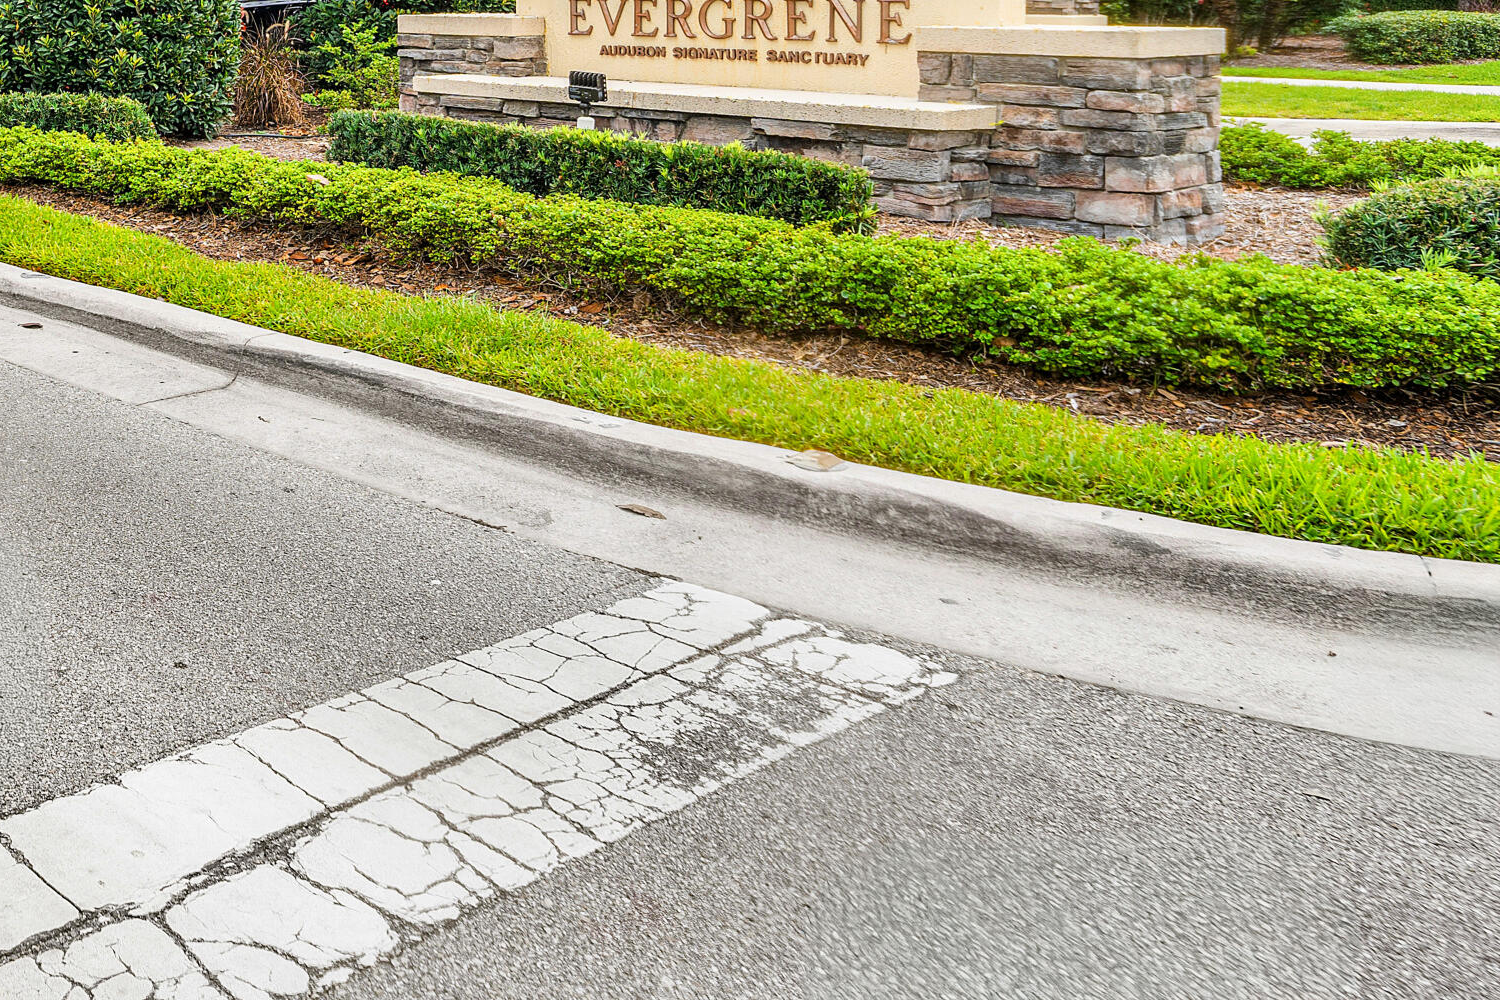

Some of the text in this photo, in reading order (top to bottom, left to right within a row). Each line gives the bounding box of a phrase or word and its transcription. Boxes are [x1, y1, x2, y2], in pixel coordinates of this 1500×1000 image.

[599, 44, 870, 67] AUDUBON SIGNATURE SANCTUARY
